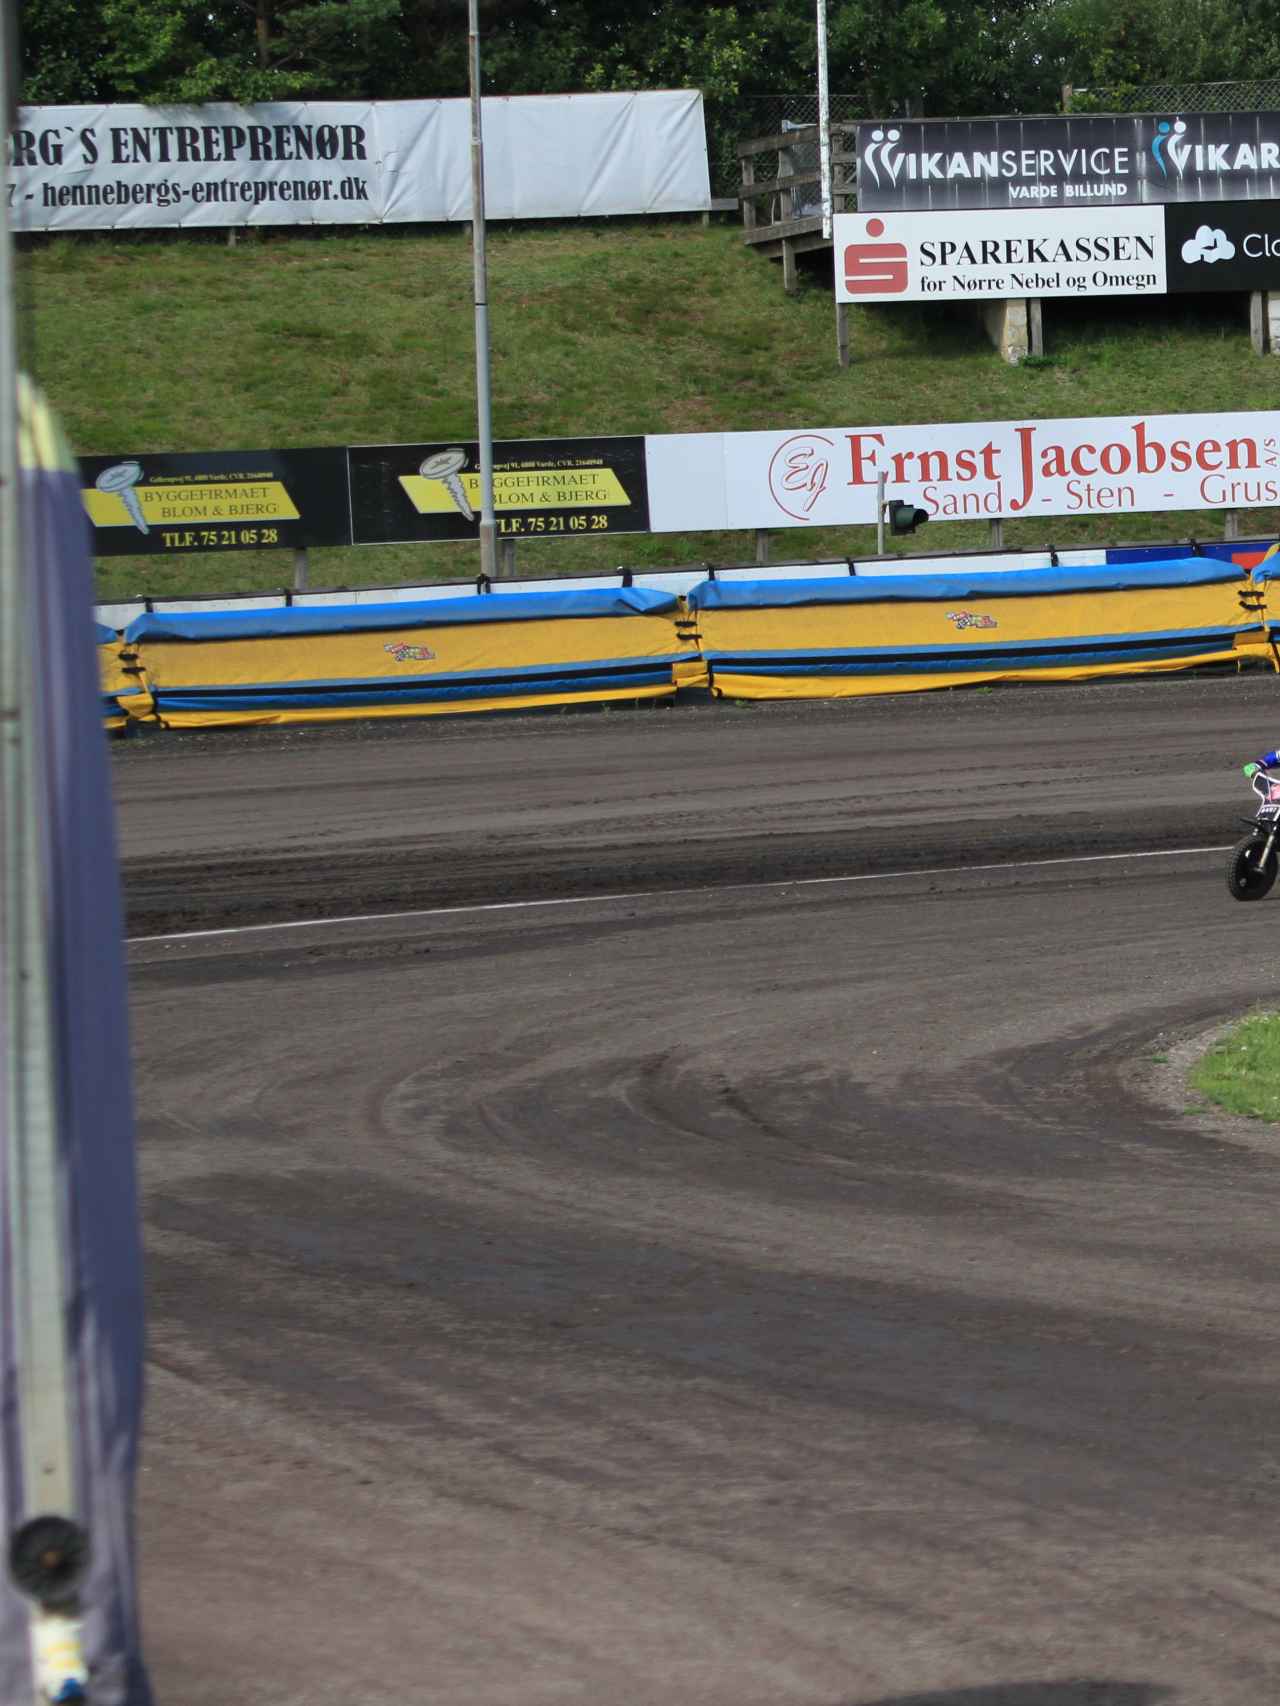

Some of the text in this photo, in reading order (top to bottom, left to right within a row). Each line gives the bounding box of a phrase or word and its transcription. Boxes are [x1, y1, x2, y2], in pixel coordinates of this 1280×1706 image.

[110, 124, 368, 164] ENTREPRENØR
[876, 147, 1130, 189] VIKANSERVICE
[42, 176, 369, 208] hennebergs-entreprenør.dk
[1009, 183, 1128, 200] VARDE BILLUND
[919, 235, 1155, 267] SPAREKASSEN
[920, 270, 1157, 293] for Nørre Nebel og Omegn
[1263, 438, 1280, 468] A/S
[845, 420, 1262, 511] Ernst Jacobsen
[468, 473, 600, 489] BGGEFIRMAET
[144, 486, 270, 502] BYGGEFIRMAET
[539, 492, 552, 503] &
[557, 489, 607, 502] BJERG
[922, 480, 1003, 516] Sand
[1066, 479, 1136, 510] Sten
[1199, 474, 1279, 504] Grus
[161, 503, 278, 518] BLOM & BJERG
[527, 517, 545, 532] 75
[549, 516, 565, 531] 21
[569, 515, 587, 530] 05
[591, 514, 608, 529] 28
[162, 528, 278, 548] TLF. 75 21 05 28
